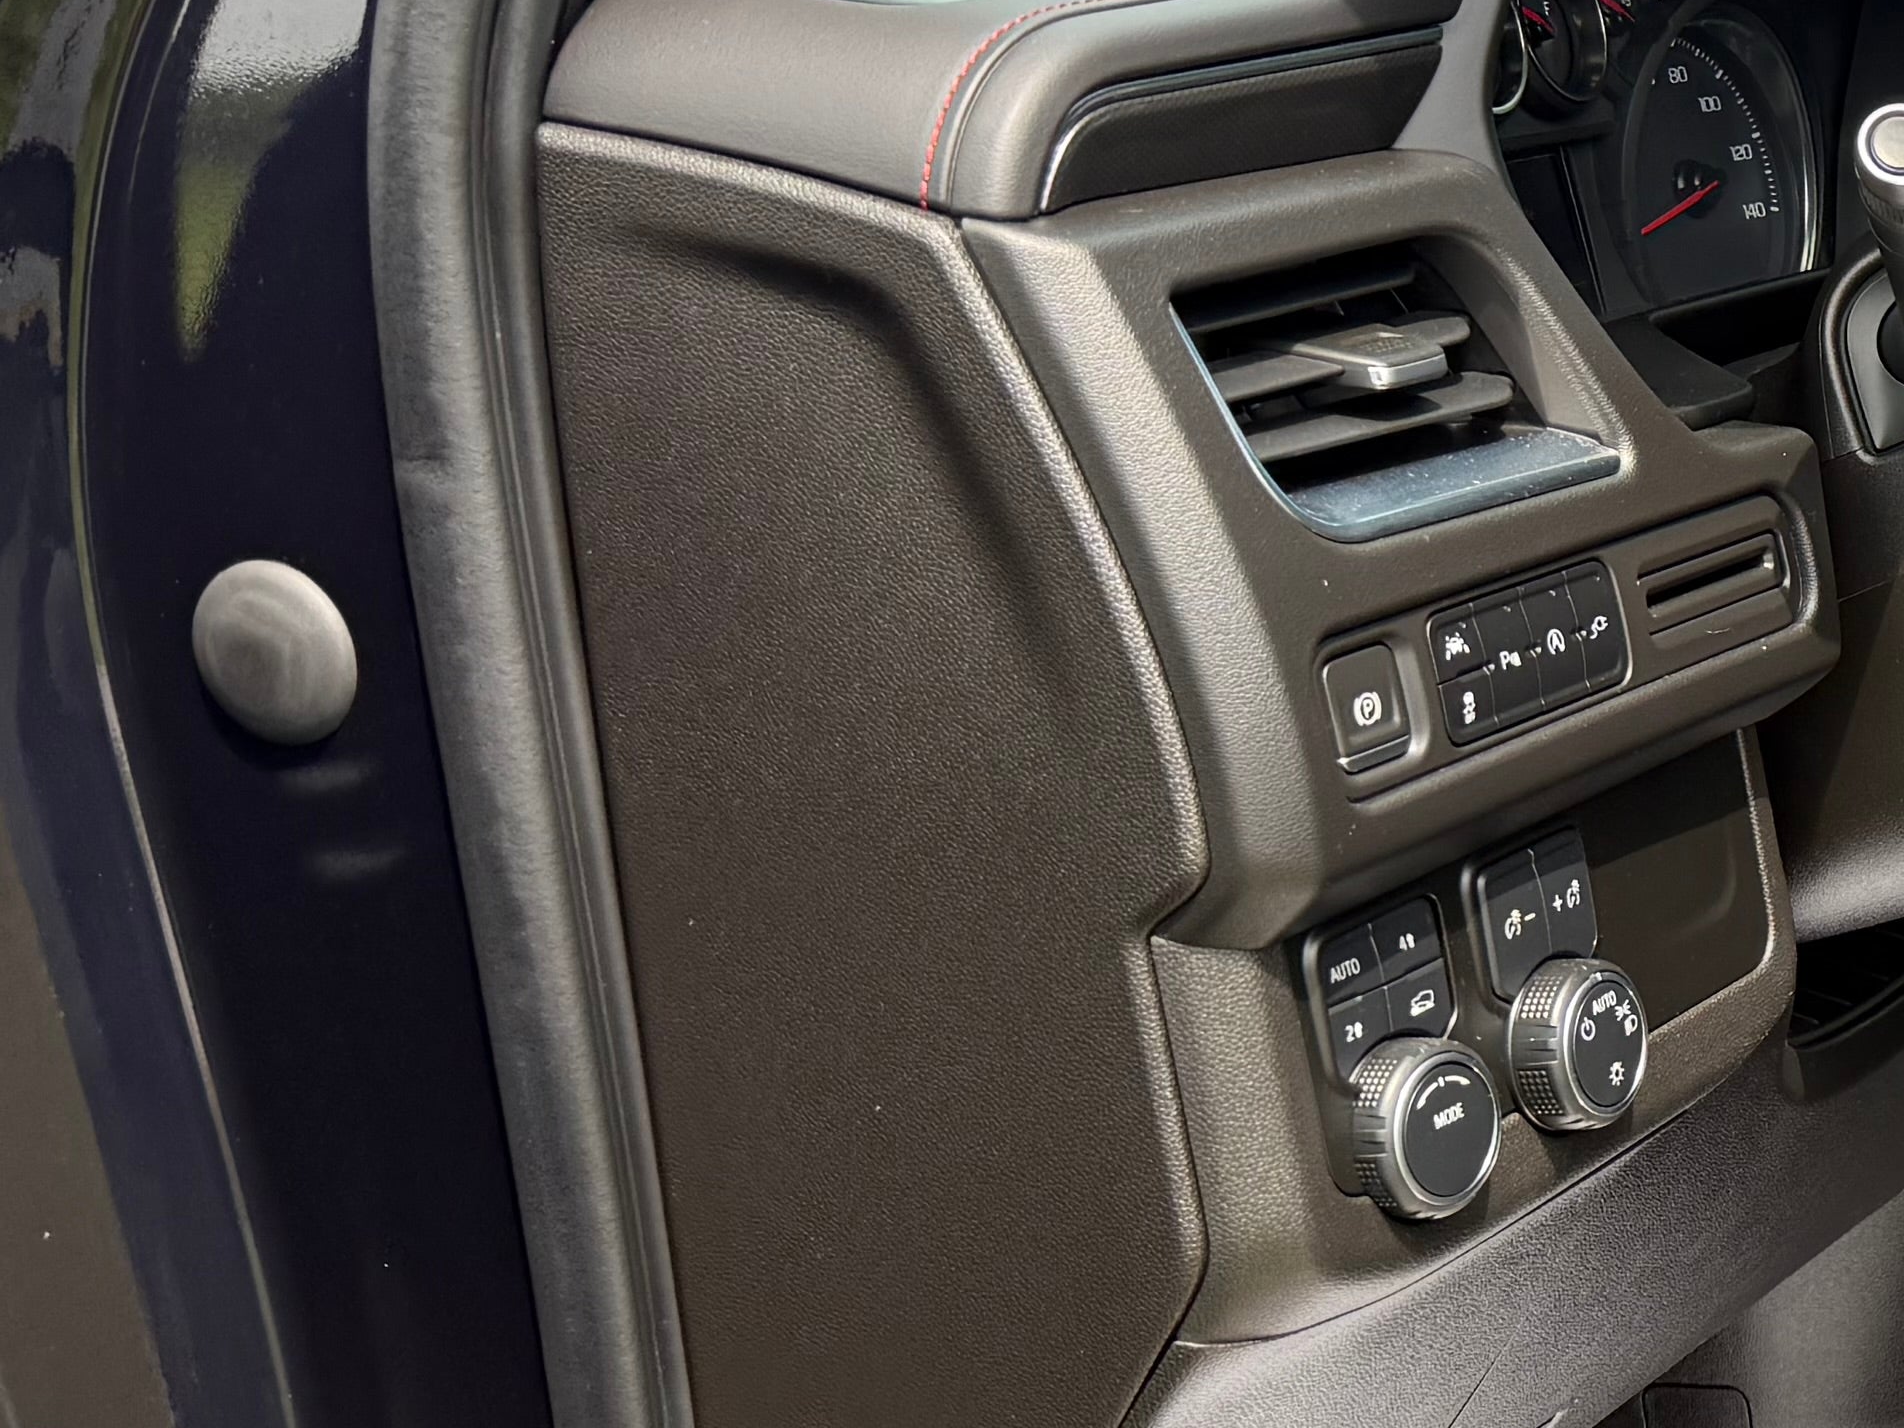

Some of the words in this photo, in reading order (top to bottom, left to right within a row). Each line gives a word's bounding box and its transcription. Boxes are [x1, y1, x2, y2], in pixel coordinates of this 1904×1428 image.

[1668, 66, 1688, 83] 80
[1698, 95, 1722, 113] 100
[1729, 143, 1753, 162] 120
[1742, 201, 1766, 219] 140
[1330, 958, 1361, 984] AUTO
[1591, 990, 1618, 1016] AUTO
[1433, 1101, 1465, 1129] MODE
